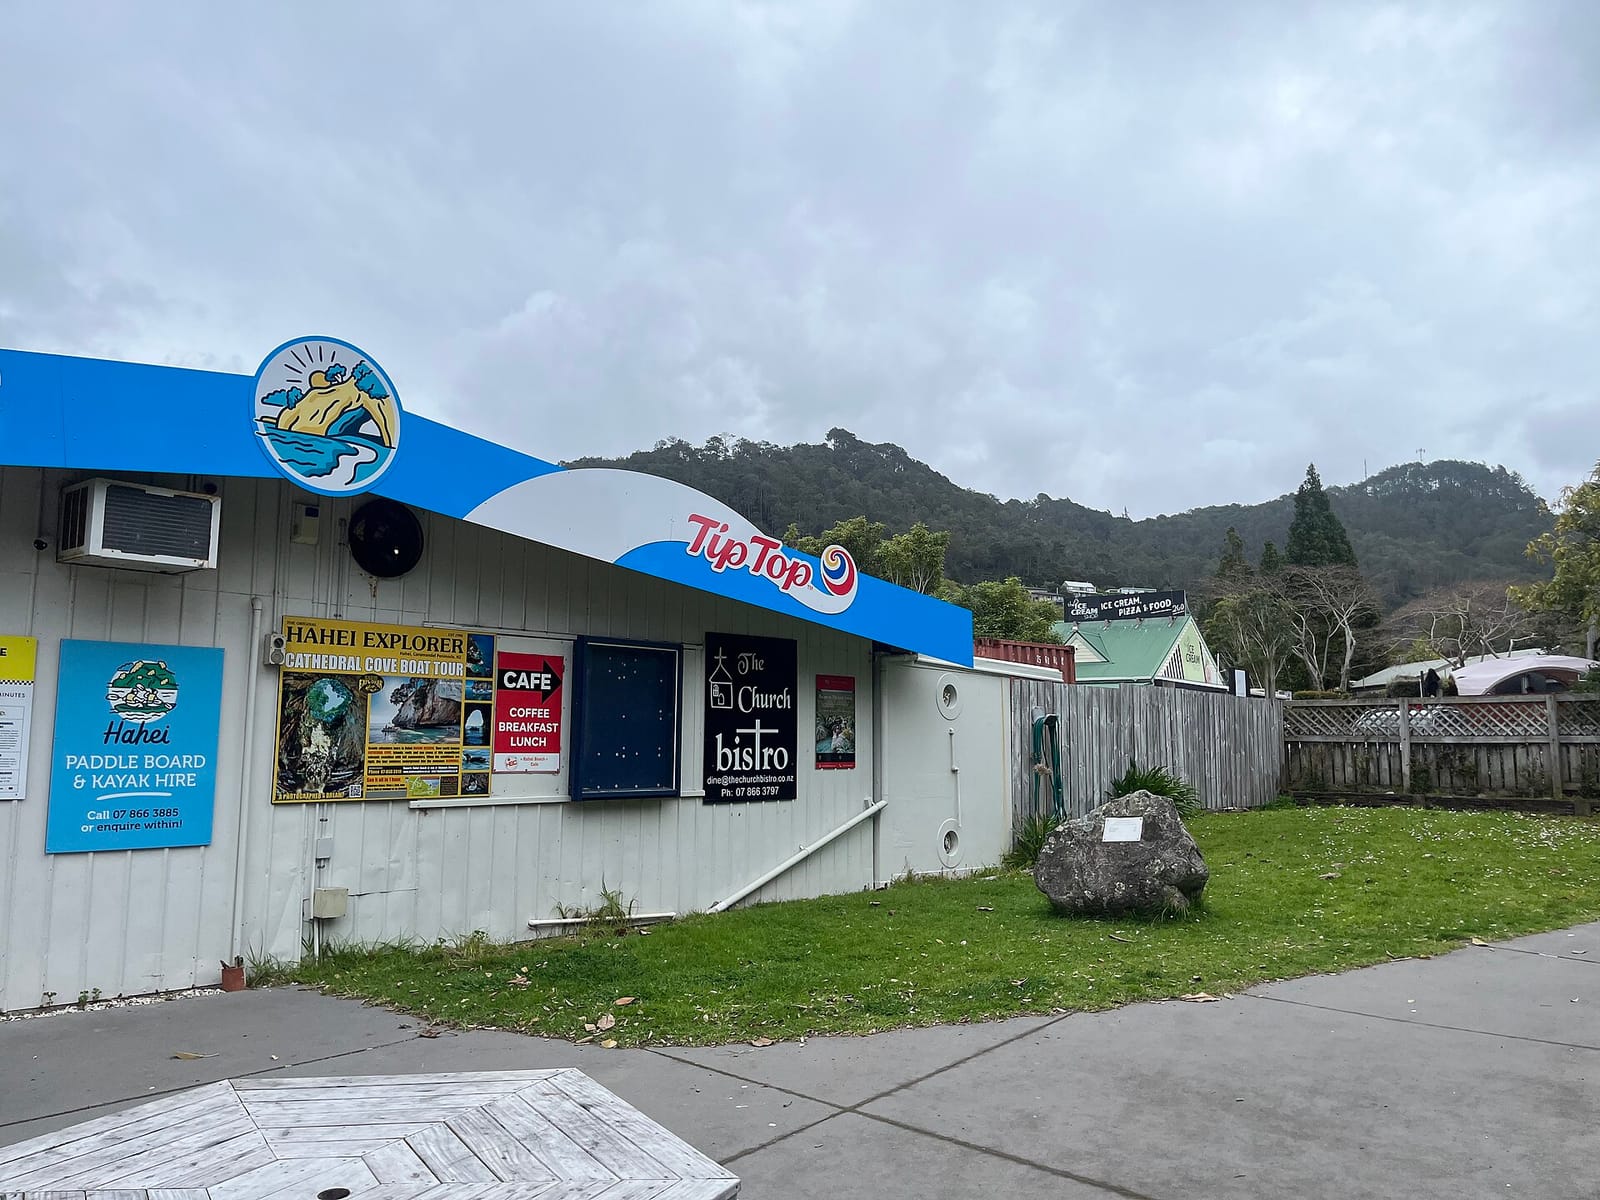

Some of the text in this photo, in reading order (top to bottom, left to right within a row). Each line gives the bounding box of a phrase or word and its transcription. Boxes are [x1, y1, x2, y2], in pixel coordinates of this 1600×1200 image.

[687, 513, 811, 590] Tip Top
[1071, 608, 1098, 616] CREAM
[1074, 602, 1088, 610] ICE
[1101, 601, 1112, 610] ICE
[1119, 605, 1141, 616] PIZZA
[1149, 599, 1172, 611] FOOD
[286, 626, 464, 653] HAHEI EXPLORER
[285, 652, 464, 677] CATHEDRAL COVE BOAT TOUR
[737, 653, 765, 675] The
[503, 671, 552, 690] CAFE
[738, 686, 791, 713] Church
[509, 707, 550, 718] COFFEE
[103, 721, 171, 745] Hahei
[498, 721, 559, 733] BREAKFAST
[510, 736, 547, 747] LUNCH
[715, 719, 789, 771] bistro
[66, 754, 206, 770] PADDLE BOARD
[73, 773, 197, 789] & KAYAK HIRE
[721, 786, 780, 798] Ph: 07 866 3797
[87, 808, 179, 820] Call 07 866 3885
[81, 819, 182, 833] or enquire within!
